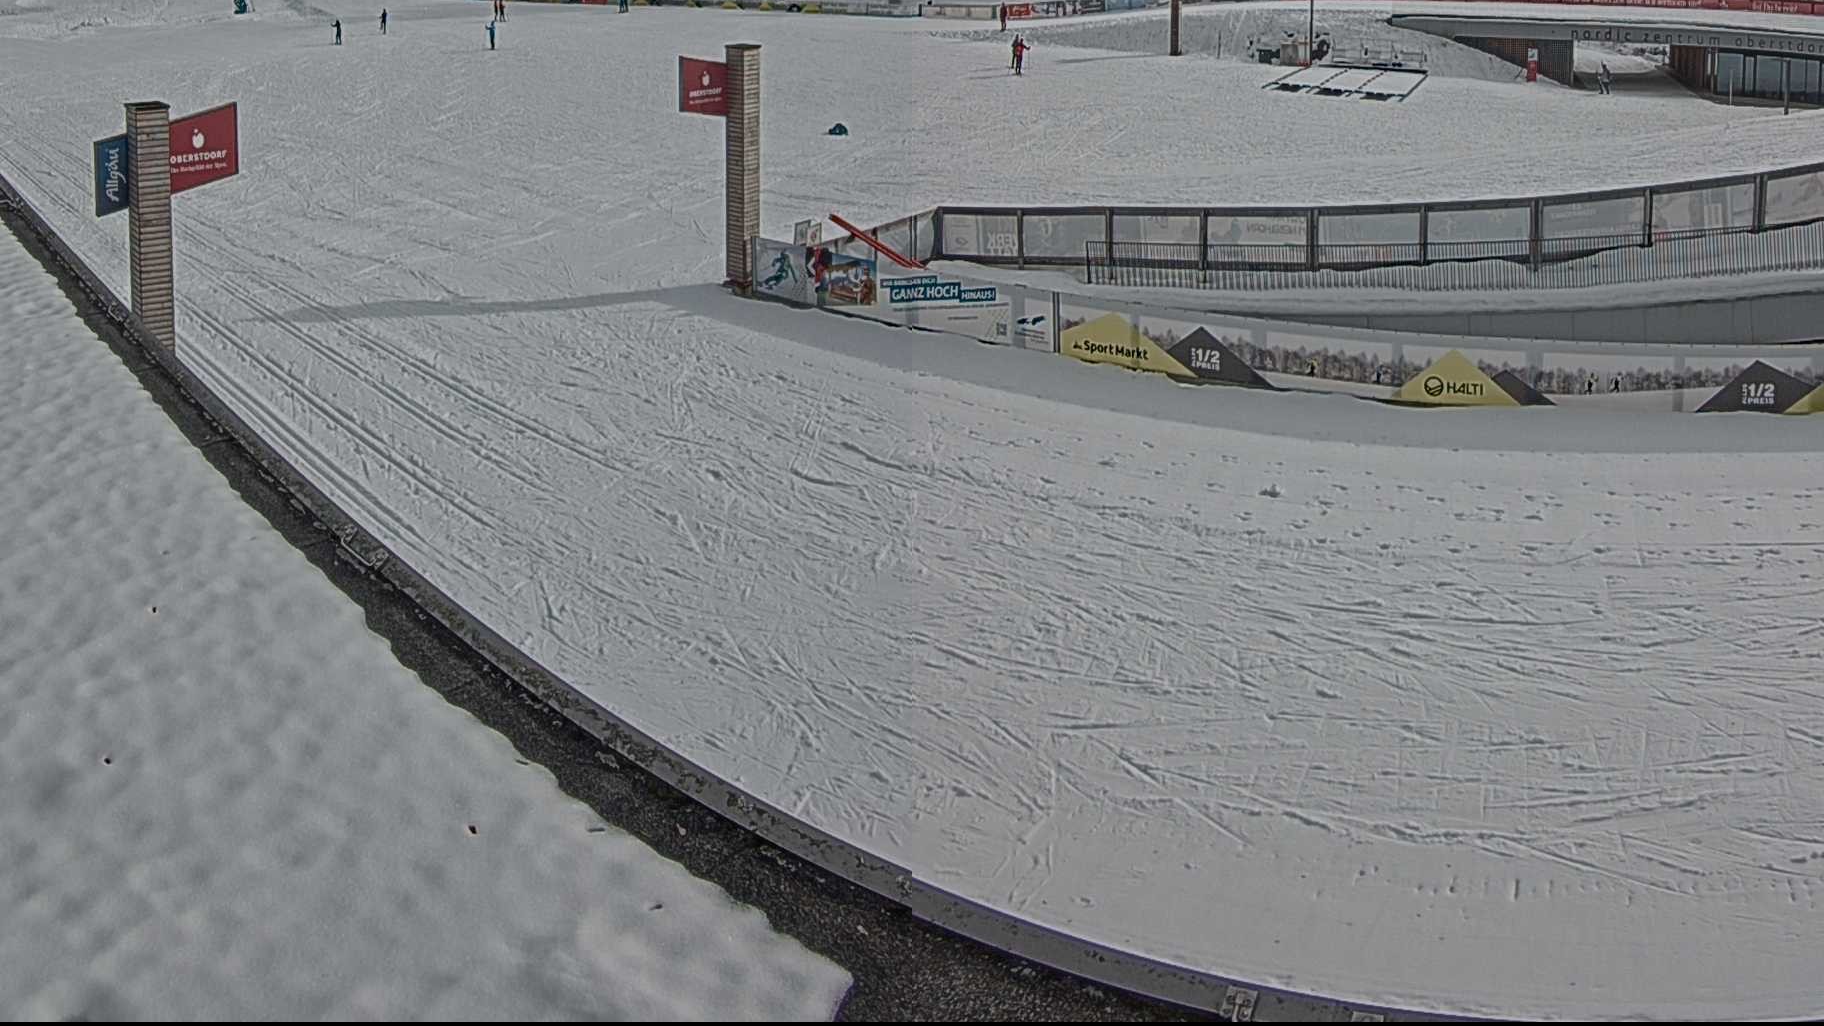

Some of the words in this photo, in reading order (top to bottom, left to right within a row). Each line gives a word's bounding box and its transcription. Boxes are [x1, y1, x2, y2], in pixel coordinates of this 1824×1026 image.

[1571, 26, 1632, 42] nordic
[1643, 31, 1721, 46] zentrum
[169, 150, 227, 164] OBERSTDORF
[105, 148, 127, 202] Allgäu
[926, 285, 959, 298] HOCH
[1083, 340, 1115, 357] Sport
[1115, 346, 1149, 361] Markt
[1196, 348, 1220, 363] 1/2
[1446, 381, 1484, 396] HALTI
[1748, 383, 1775, 397] 1/2
